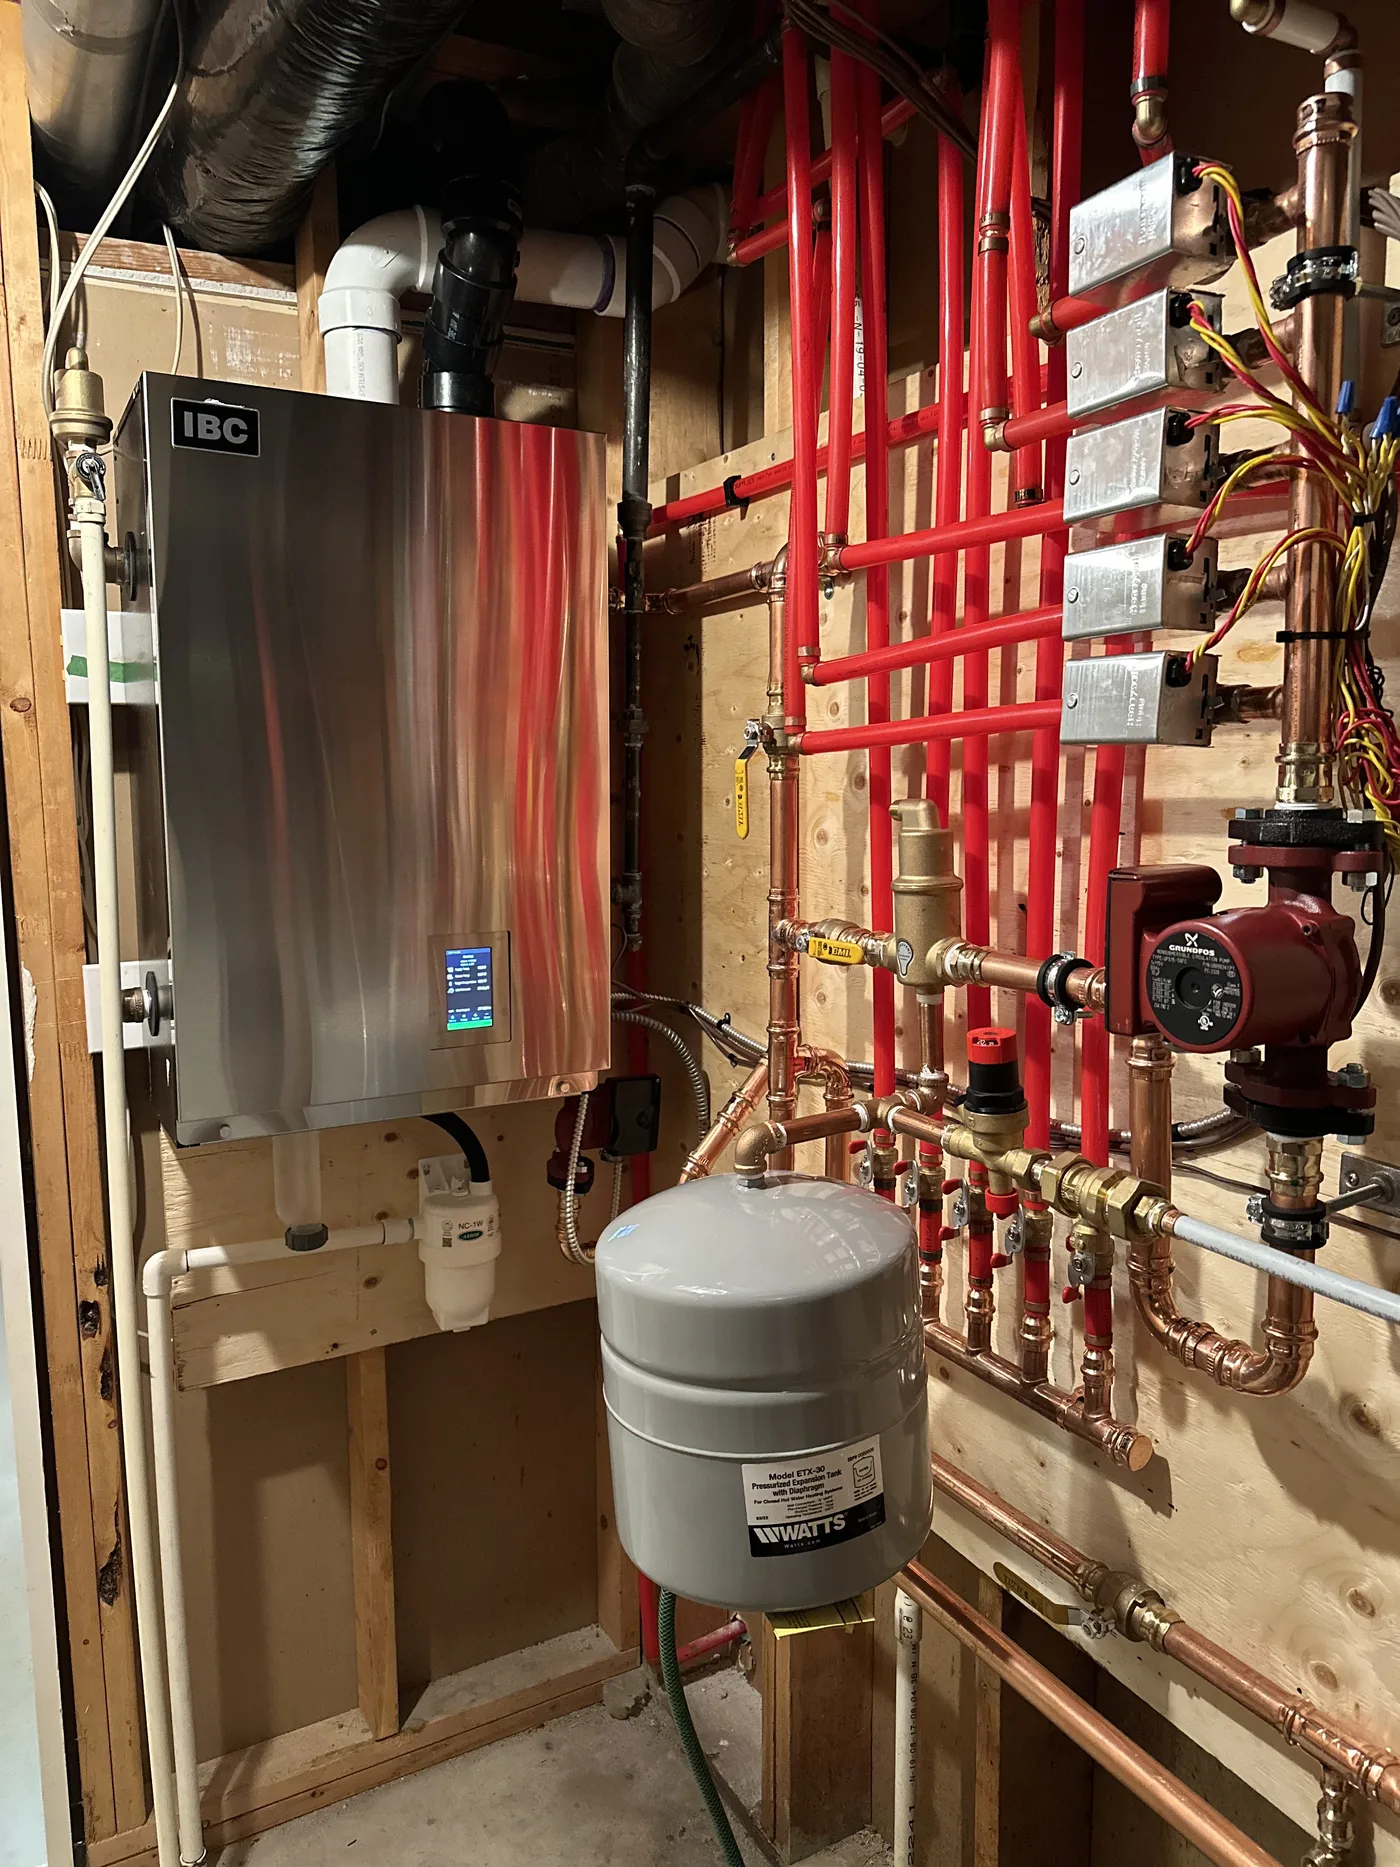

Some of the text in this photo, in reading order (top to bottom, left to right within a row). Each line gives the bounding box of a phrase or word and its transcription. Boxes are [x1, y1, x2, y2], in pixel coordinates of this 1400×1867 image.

[184, 411, 248, 444] IBC
[1168, 944, 1215, 957] GRUNDFOS
[458, 1220, 484, 1230] NC-1W
[751, 1469, 842, 1490] Pressurized Expansion Tank
[769, 1465, 826, 1481] Model ETX-30
[772, 1483, 825, 1497] with Diaphragm
[805, 1492, 824, 1500] Heating
[772, 1513, 846, 1543] WATTS
[784, 1539, 820, 1549] Watts.com
